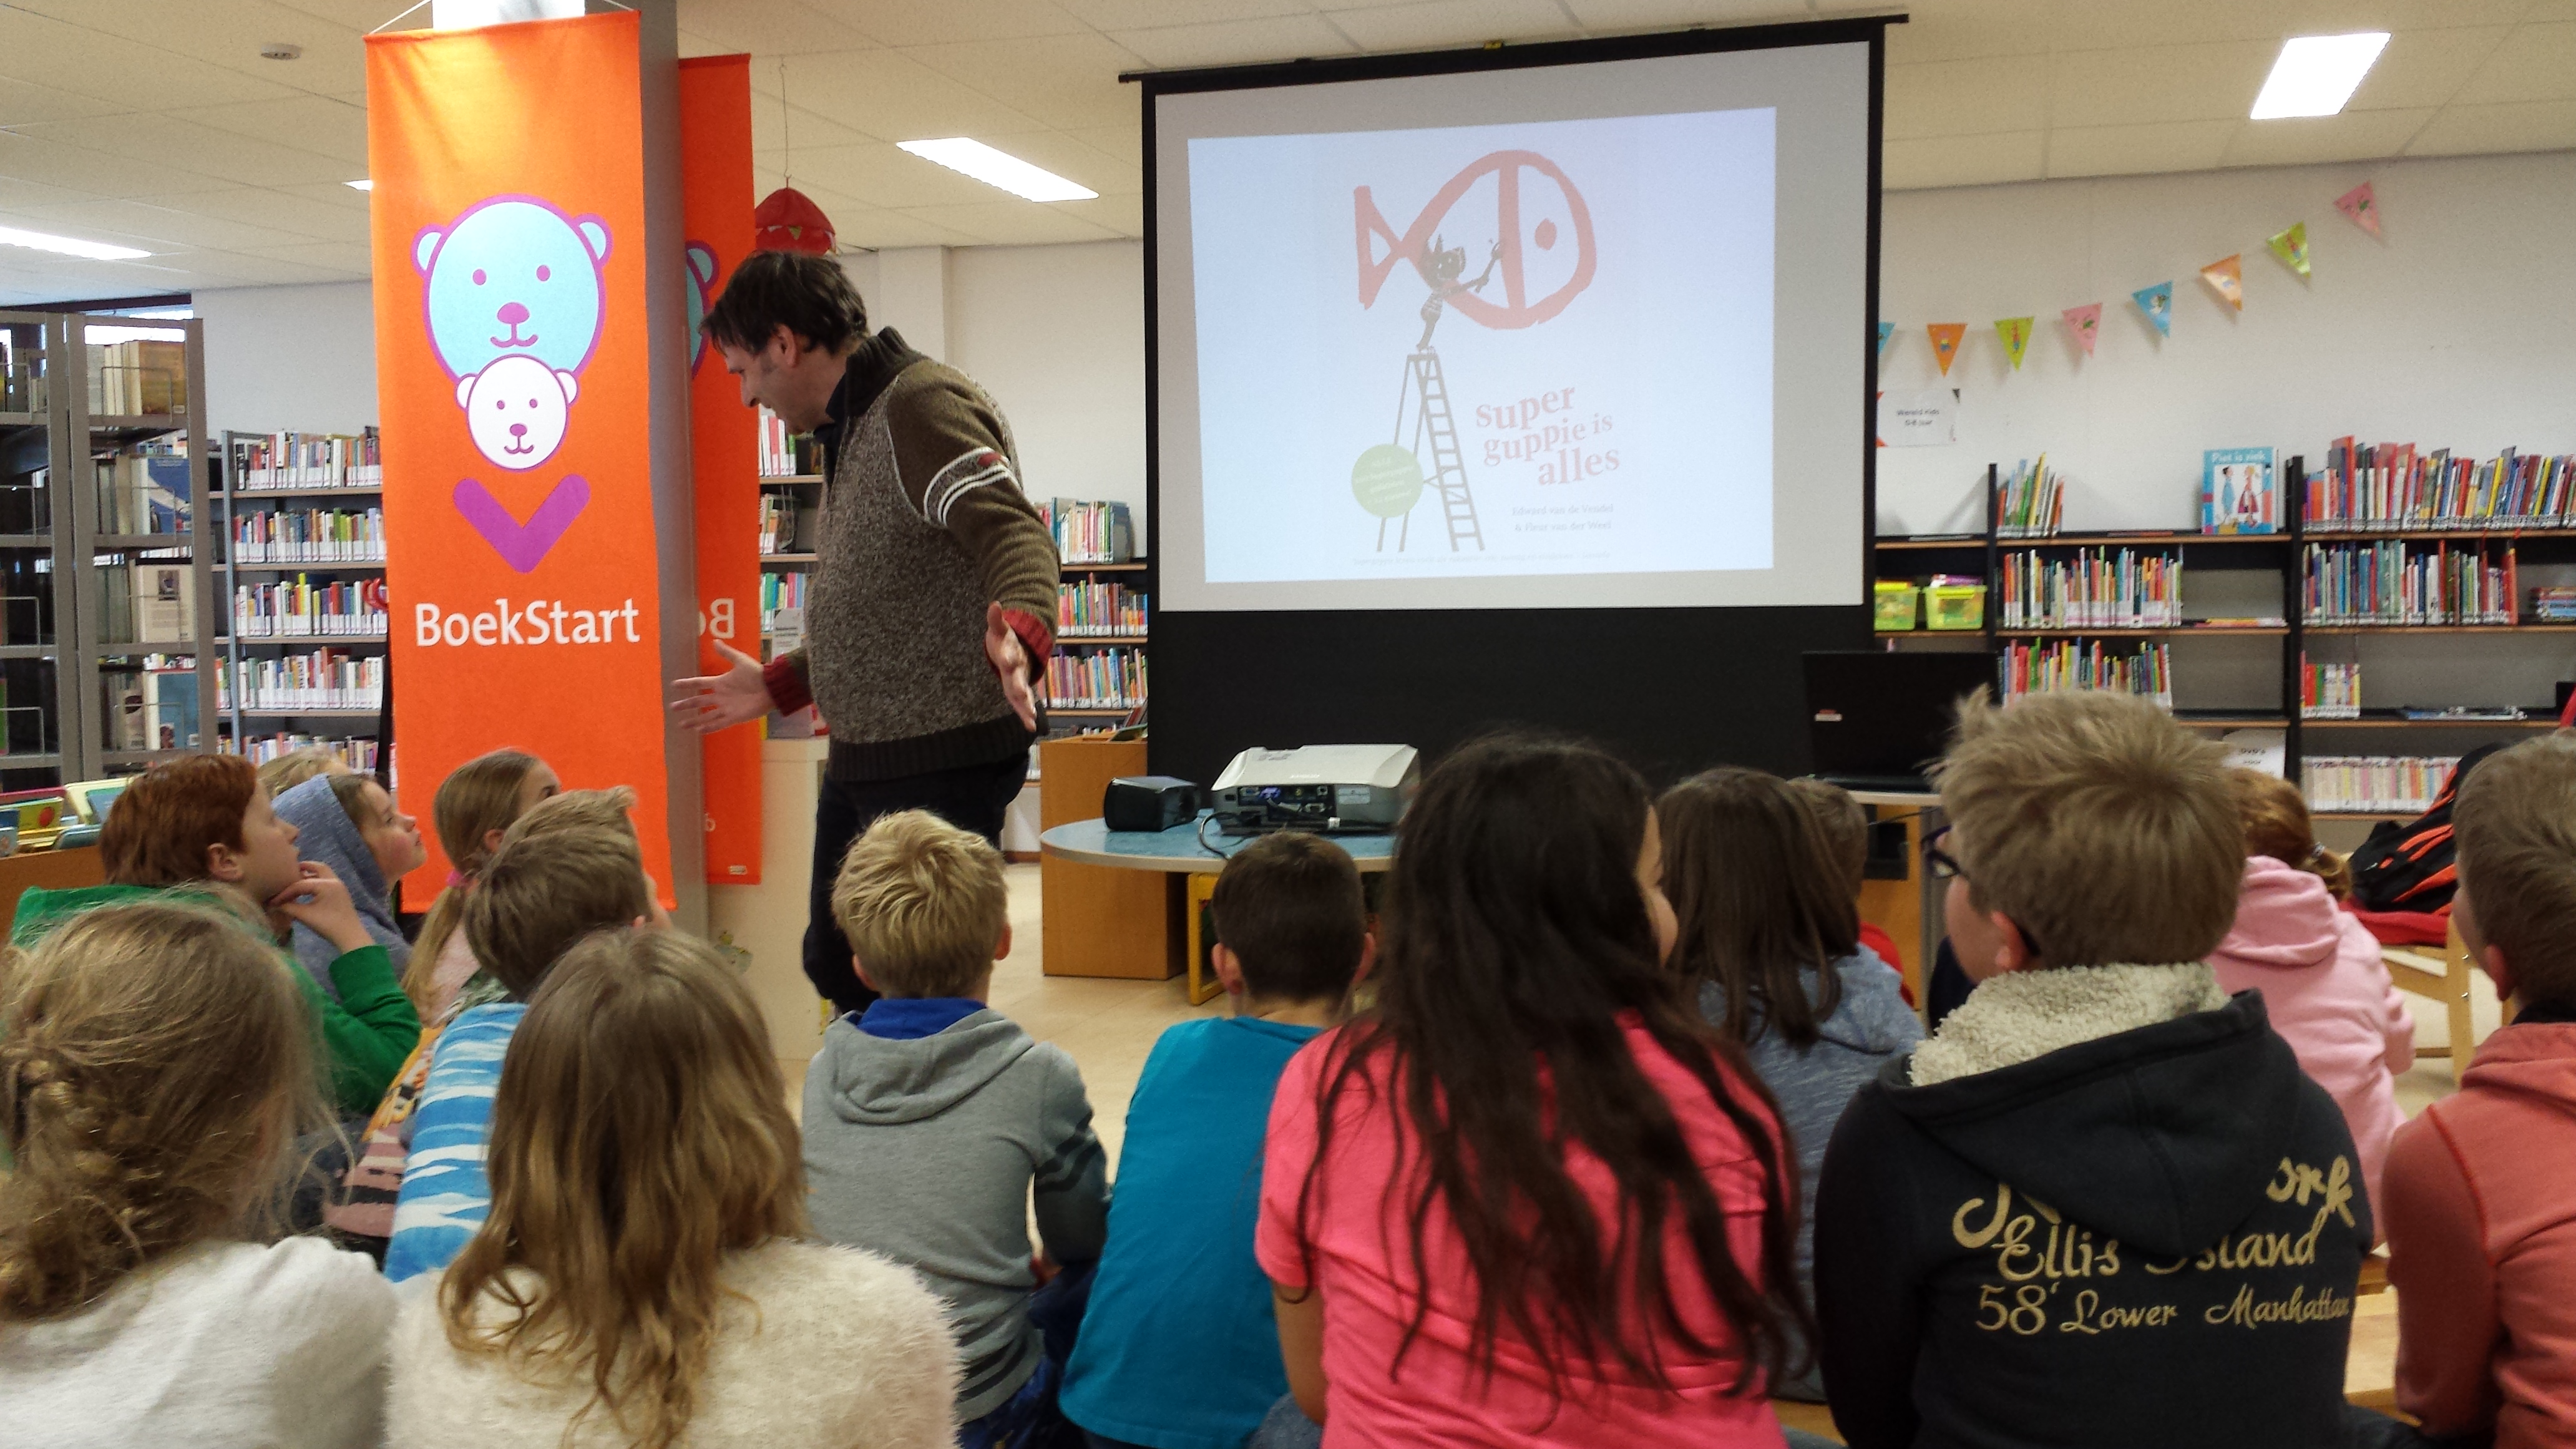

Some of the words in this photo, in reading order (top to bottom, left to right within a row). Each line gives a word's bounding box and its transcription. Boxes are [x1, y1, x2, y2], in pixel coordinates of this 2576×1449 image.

[1476, 387, 1576, 430] super
[1483, 417, 1587, 467] guppie
[1593, 412, 1612, 434] is
[1538, 447, 1620, 485] alles
[1511, 505, 1547, 516] Edward
[1568, 505, 1579, 514] de
[1581, 504, 1614, 514] Vendel
[1525, 522, 1548, 532] Fleur
[1570, 522, 1586, 530] der
[415, 598, 640, 646] BoekStart
[1991, 1214, 2120, 1281] Ellis
[2145, 1206, 2331, 1275] sland
[2059, 1289, 2178, 1335] Lower
[2204, 1282, 2350, 1330] Manhattan
